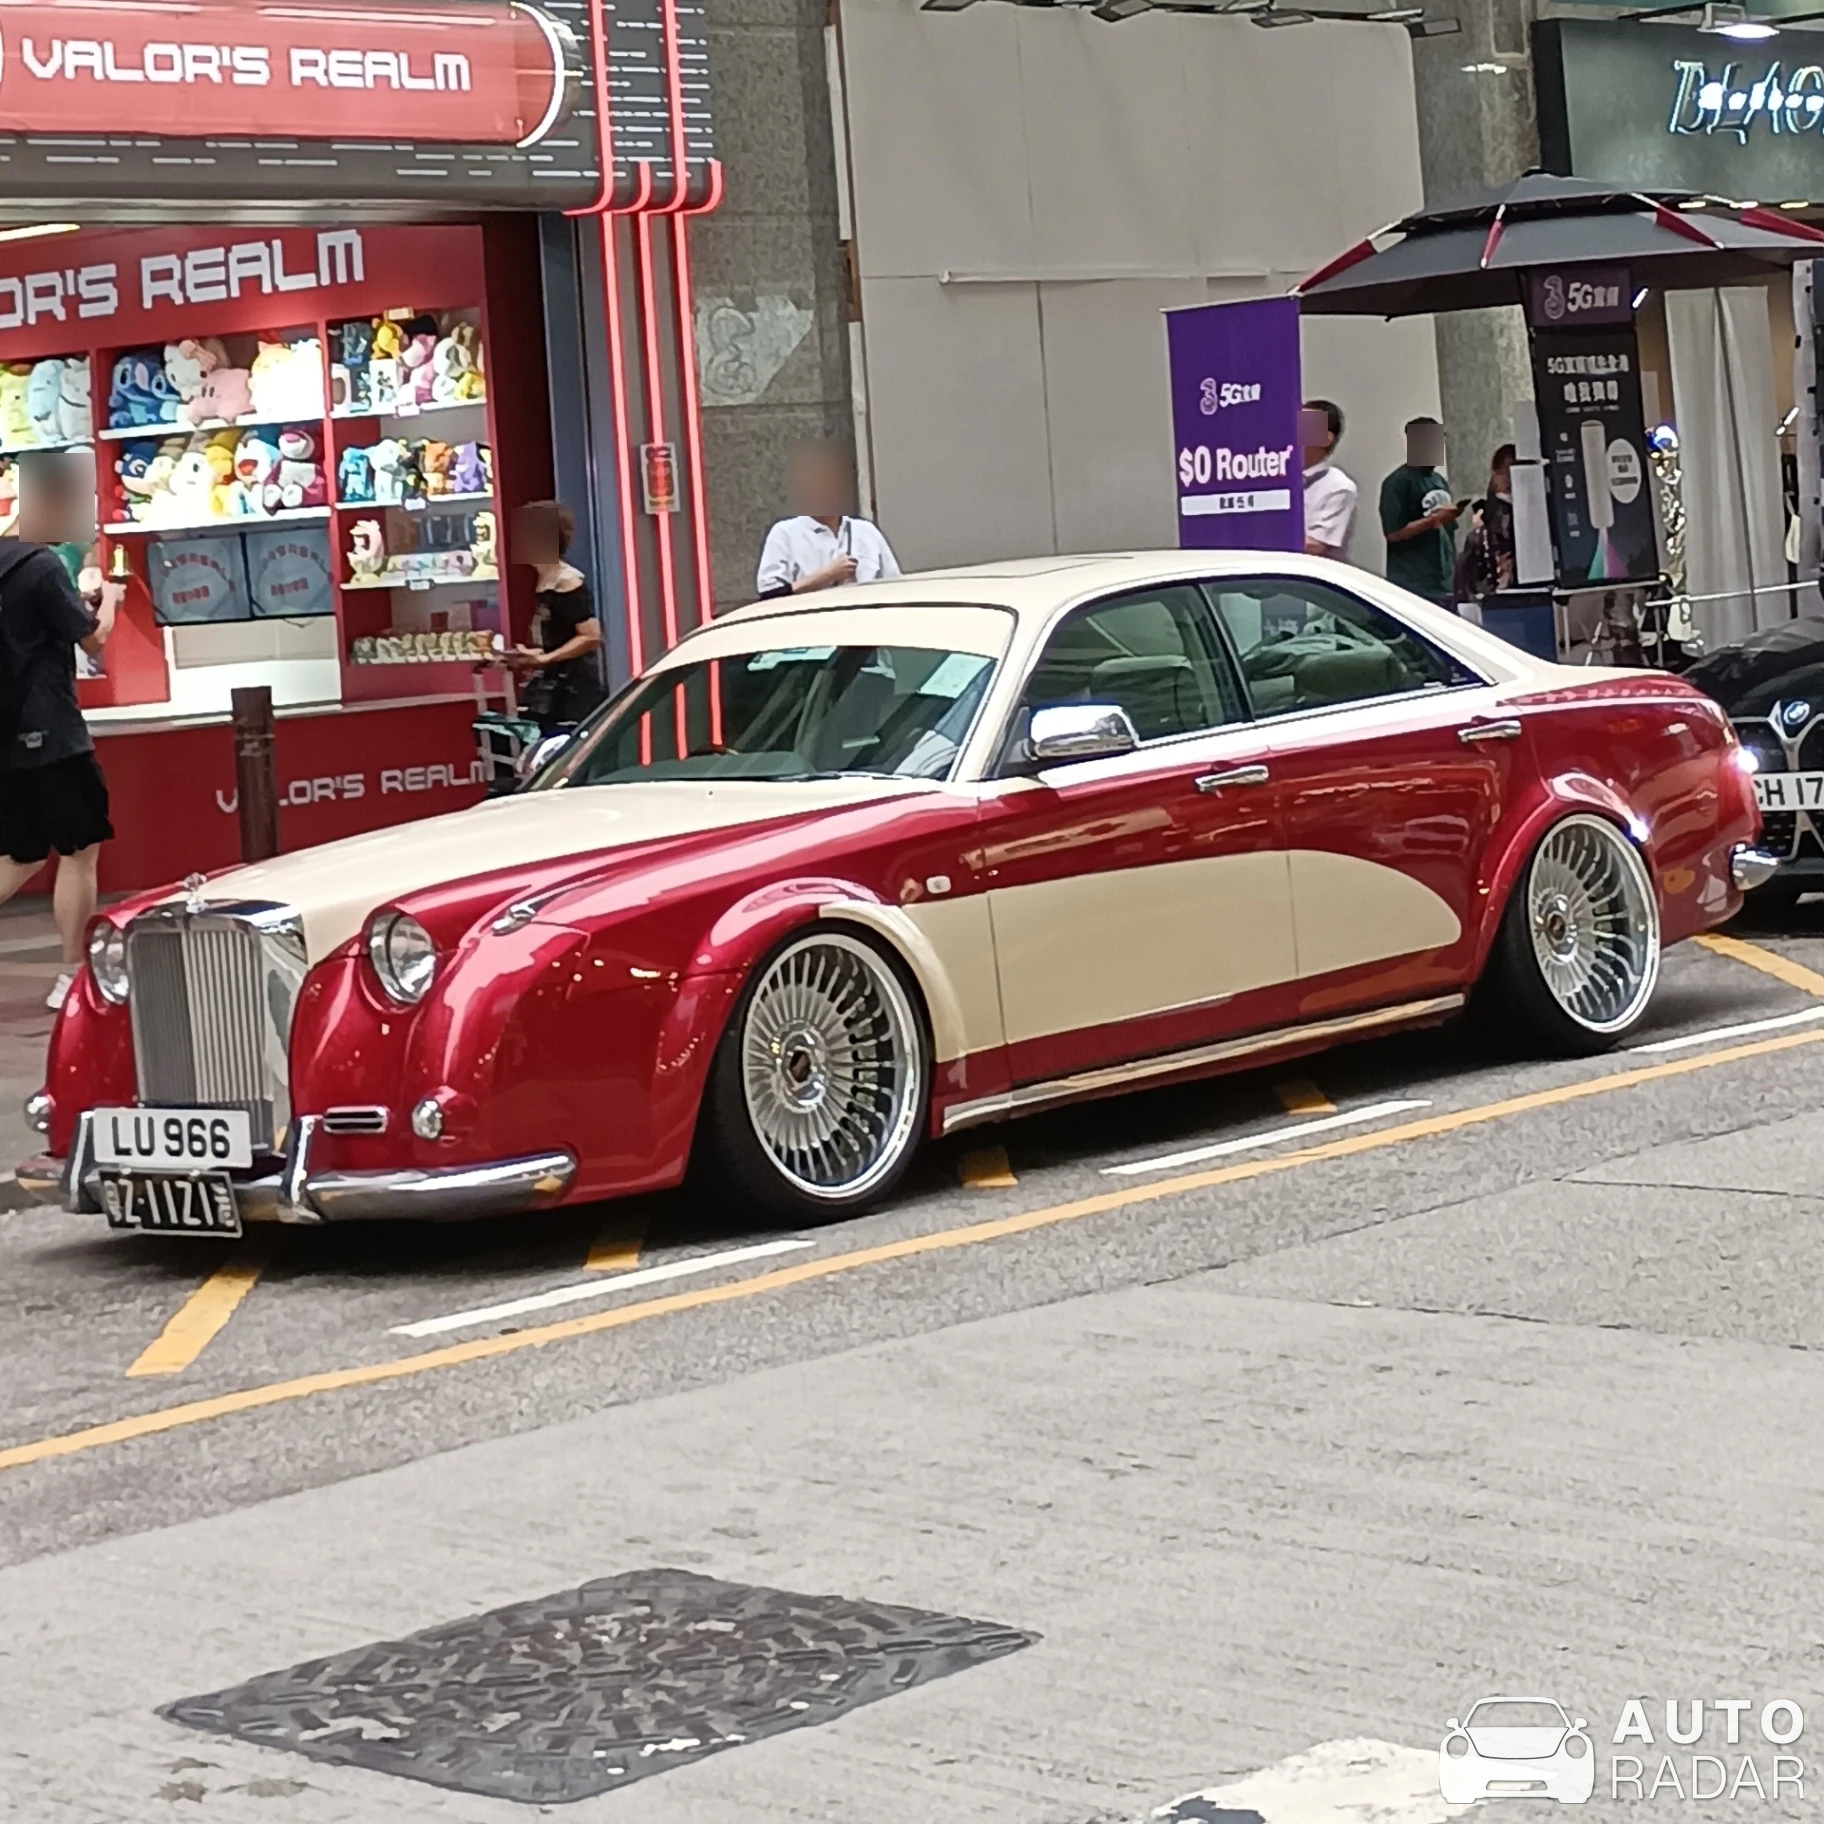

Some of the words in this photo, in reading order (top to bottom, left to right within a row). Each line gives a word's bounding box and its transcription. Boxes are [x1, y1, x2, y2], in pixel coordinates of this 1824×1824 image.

[21, 37, 271, 85] VALOR'S
[290, 47, 471, 91] REALM
[141, 229, 364, 309] REALM
[1179, 445, 1212, 488] $0
[215, 773, 365, 814] VOR'S
[111, 1116, 156, 1157] LU
[163, 1117, 231, 1159] 966
